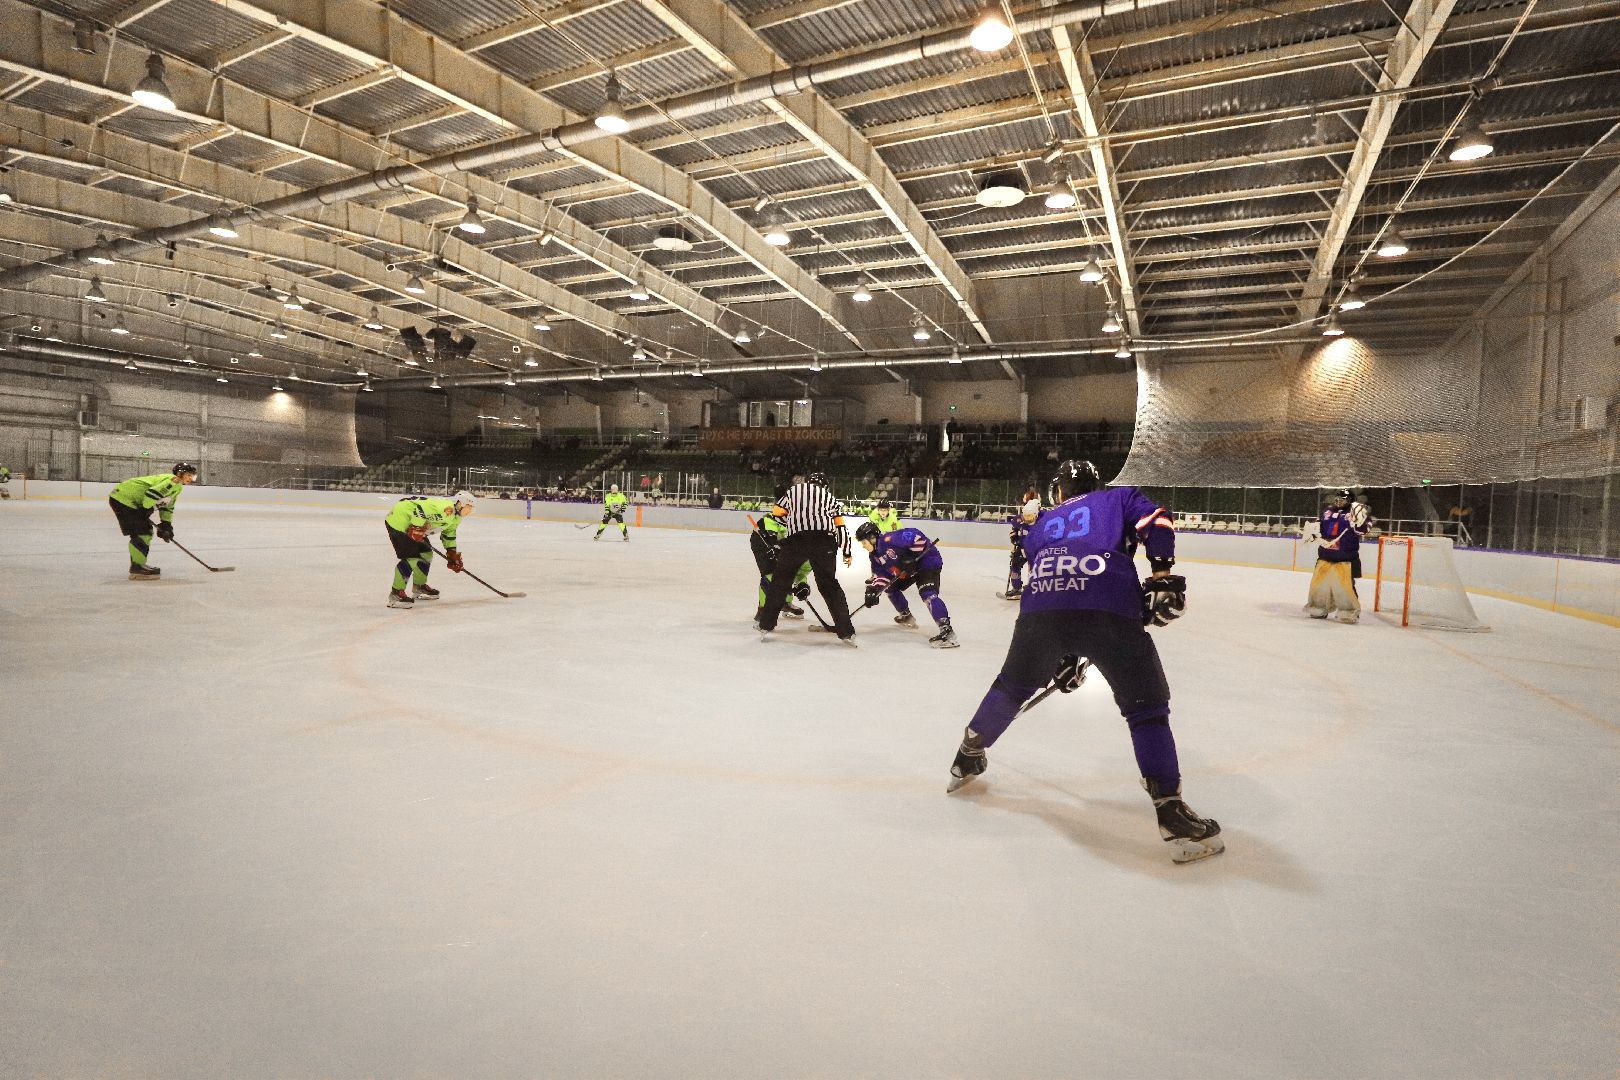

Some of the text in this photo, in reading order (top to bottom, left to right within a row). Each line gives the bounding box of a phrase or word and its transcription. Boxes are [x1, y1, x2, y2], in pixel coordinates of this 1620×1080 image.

[727, 430, 740, 440] НЕ
[743, 430, 782, 440] ИГРАЕТ
[1030, 577, 1089, 594] SWEAT
